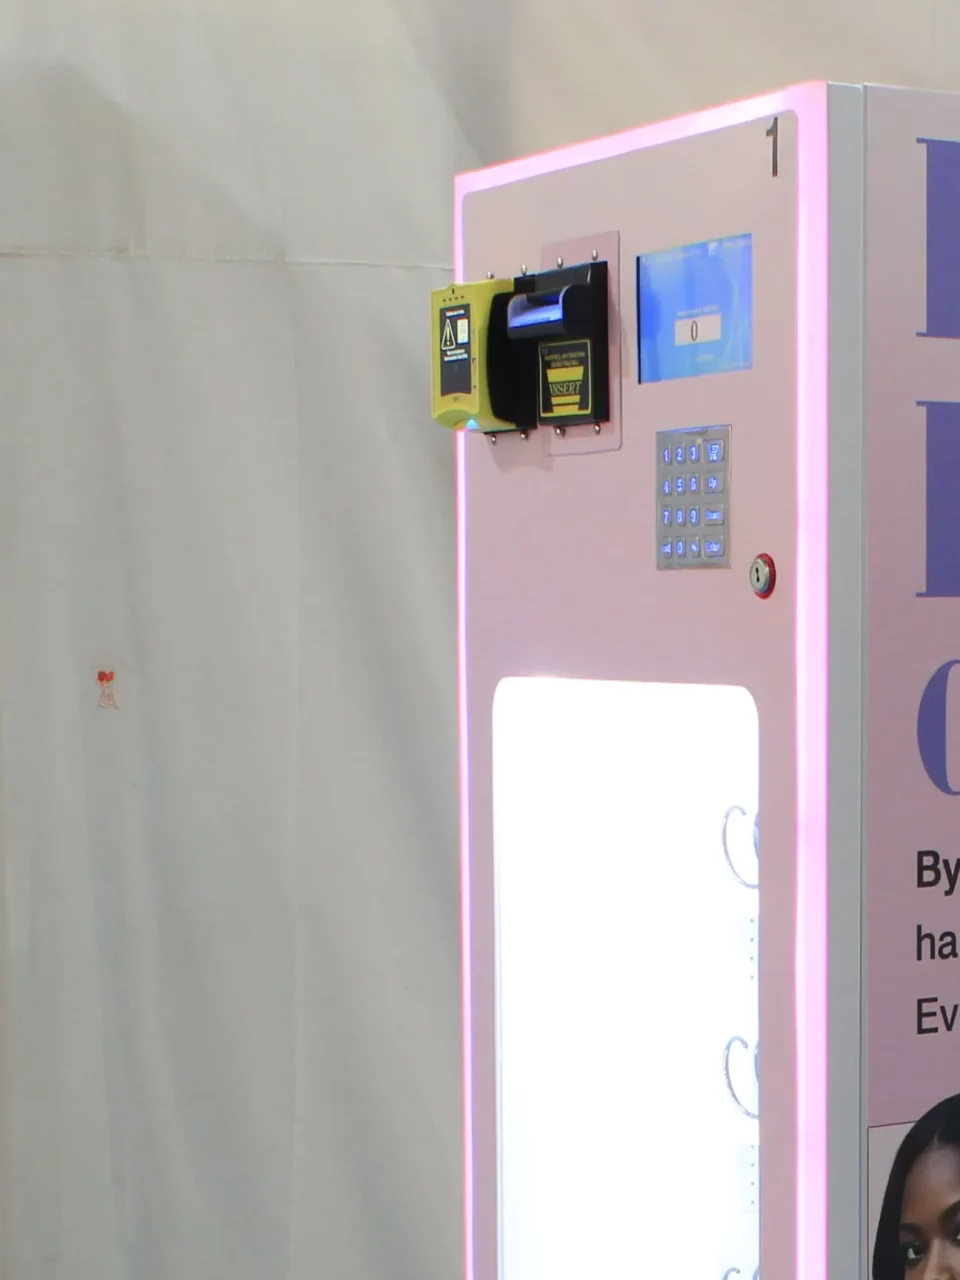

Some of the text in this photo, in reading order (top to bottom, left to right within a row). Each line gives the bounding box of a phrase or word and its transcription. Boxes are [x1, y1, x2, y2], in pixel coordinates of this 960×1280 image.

[766, 116, 778, 177] 1
[691, 320, 698, 342] 0
[549, 381, 582, 396] INSERT
[676, 447, 682, 461] 2
[691, 446, 696, 460] 3
